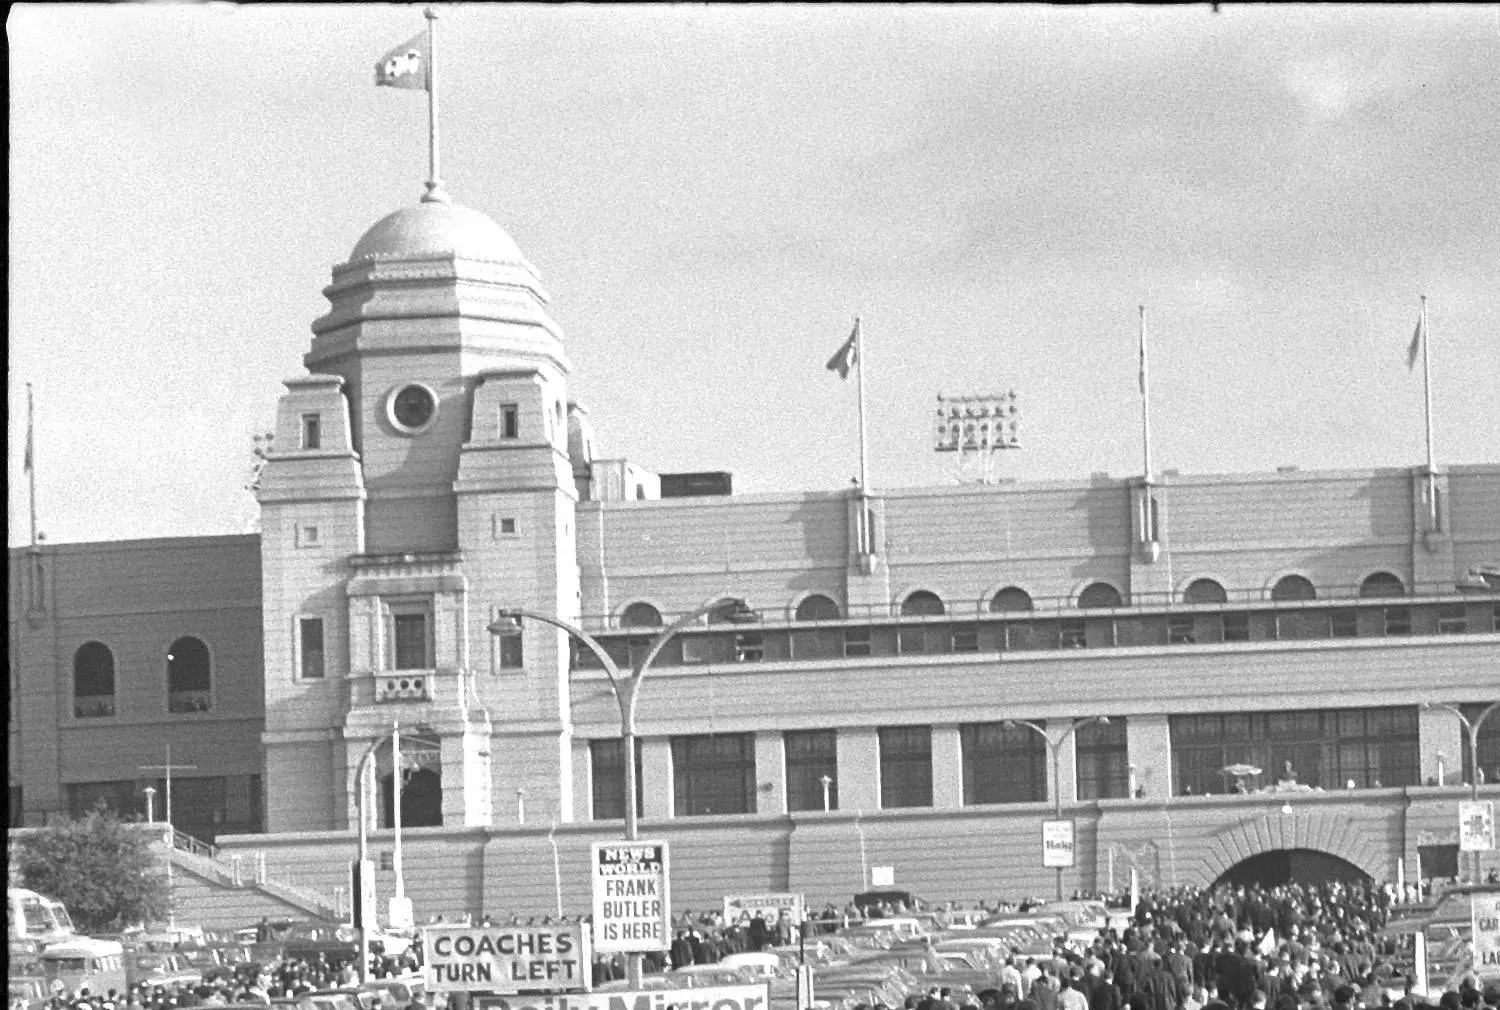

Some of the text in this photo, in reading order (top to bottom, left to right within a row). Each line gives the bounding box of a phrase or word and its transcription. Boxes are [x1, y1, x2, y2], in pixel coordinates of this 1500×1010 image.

[605, 847, 656, 861] NEWS
[600, 862, 660, 875] WORLD
[607, 879, 656, 897] FRANK
[603, 900, 660, 919] BUTLER
[604, 922, 660, 940] IS HERE
[434, 932, 573, 956] COACHES
[431, 959, 577, 983] TURN LEFT
